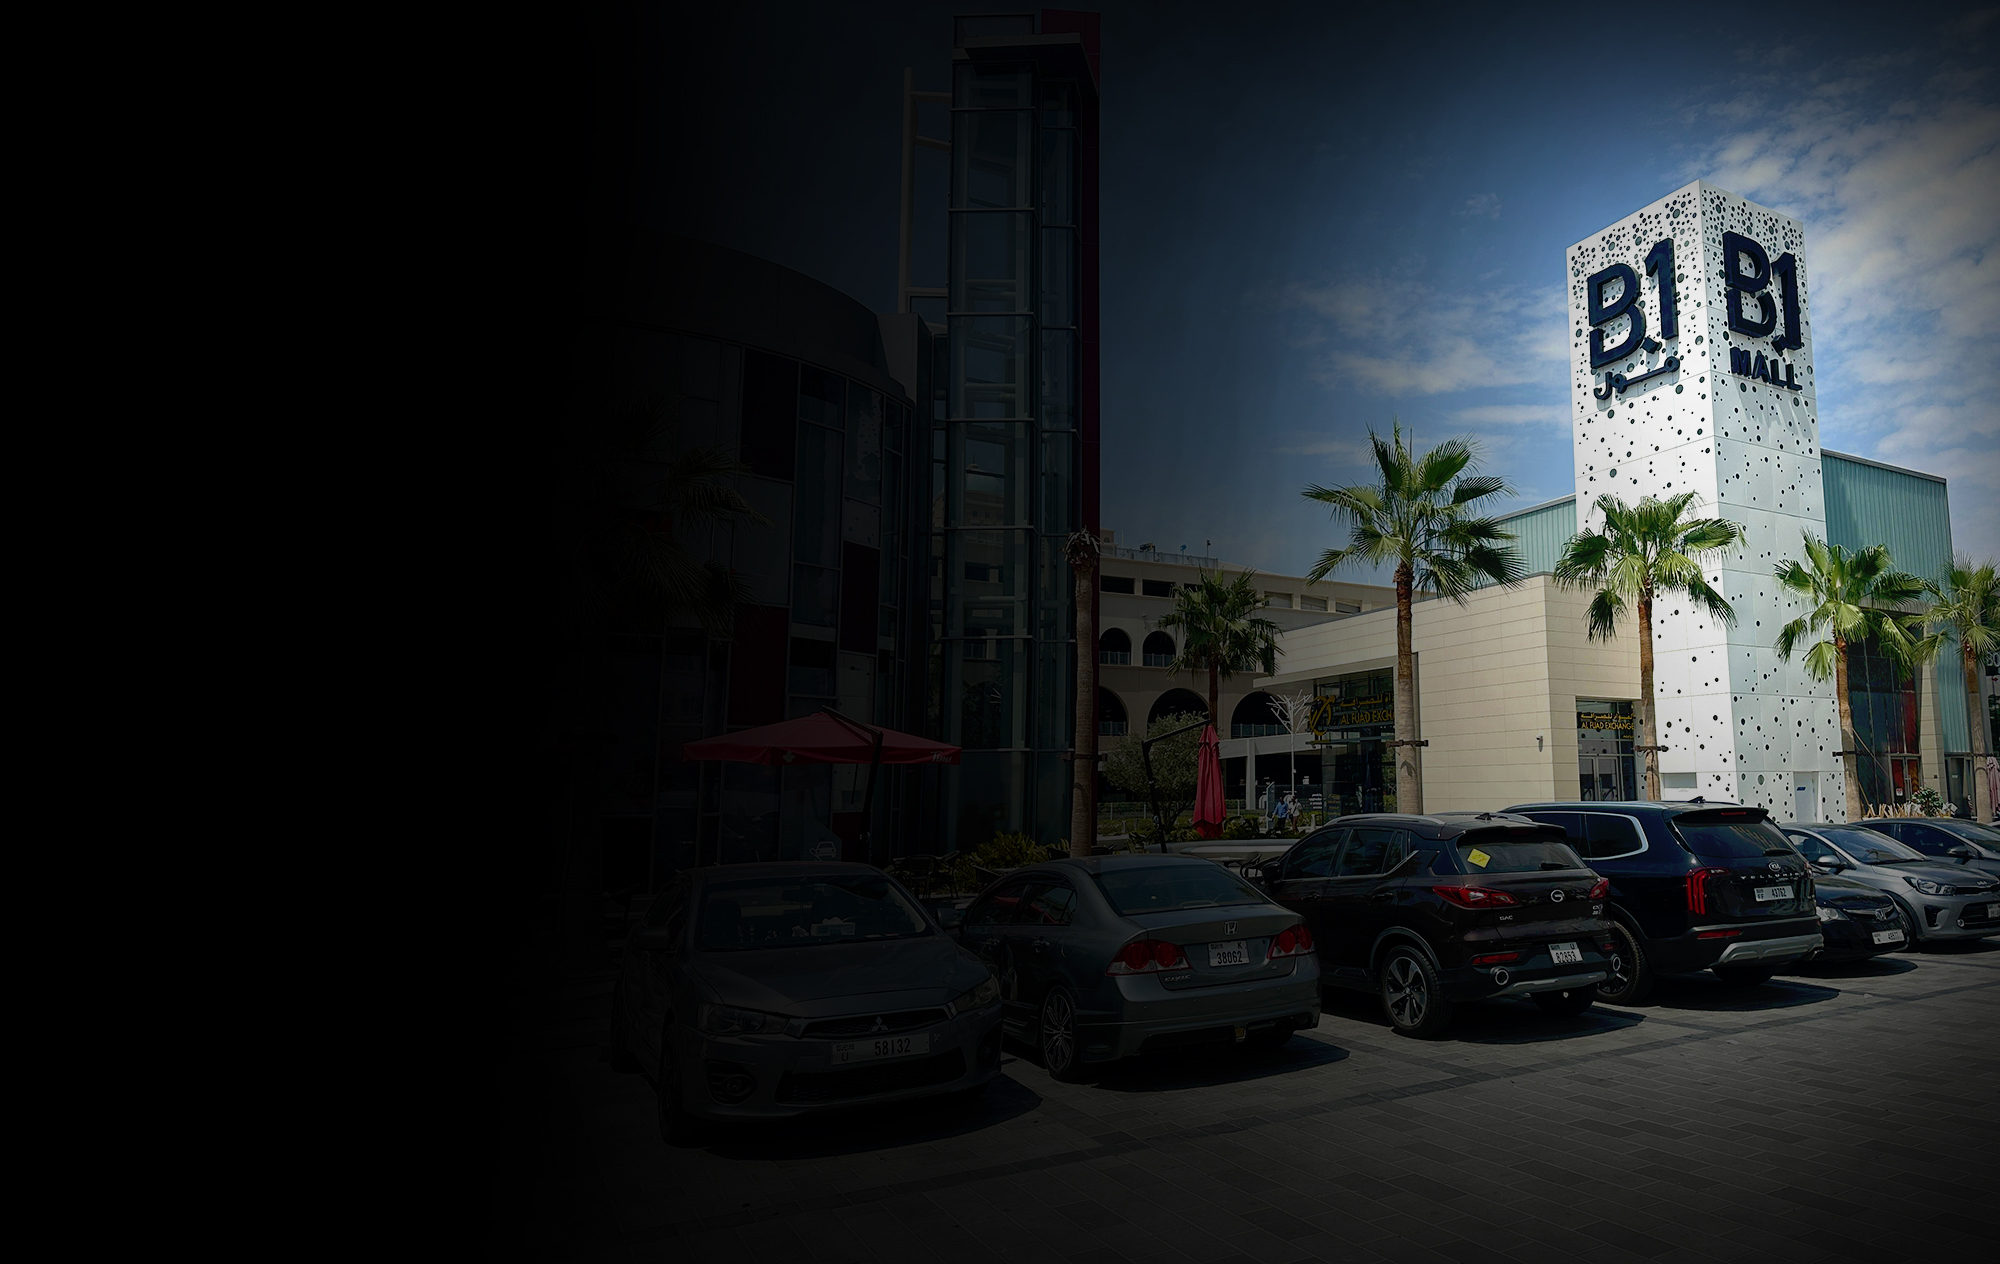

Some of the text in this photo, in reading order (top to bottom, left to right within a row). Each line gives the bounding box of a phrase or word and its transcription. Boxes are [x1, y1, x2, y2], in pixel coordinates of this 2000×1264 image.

[1722, 230, 1803, 356] B1
[1586, 237, 1680, 369] B1
[1730, 346, 1803, 391] MALL
[1593, 355, 1680, 401] مول
[1341, 713, 1349, 725] AL
[1352, 711, 1370, 724] FUAD
[1237, 941, 1242, 949] K
[1216, 950, 1243, 965] 38062
[1164, 974, 1192, 982] CIVIC
[874, 1037, 911, 1056] 58132
[841, 1052, 849, 1062] U
